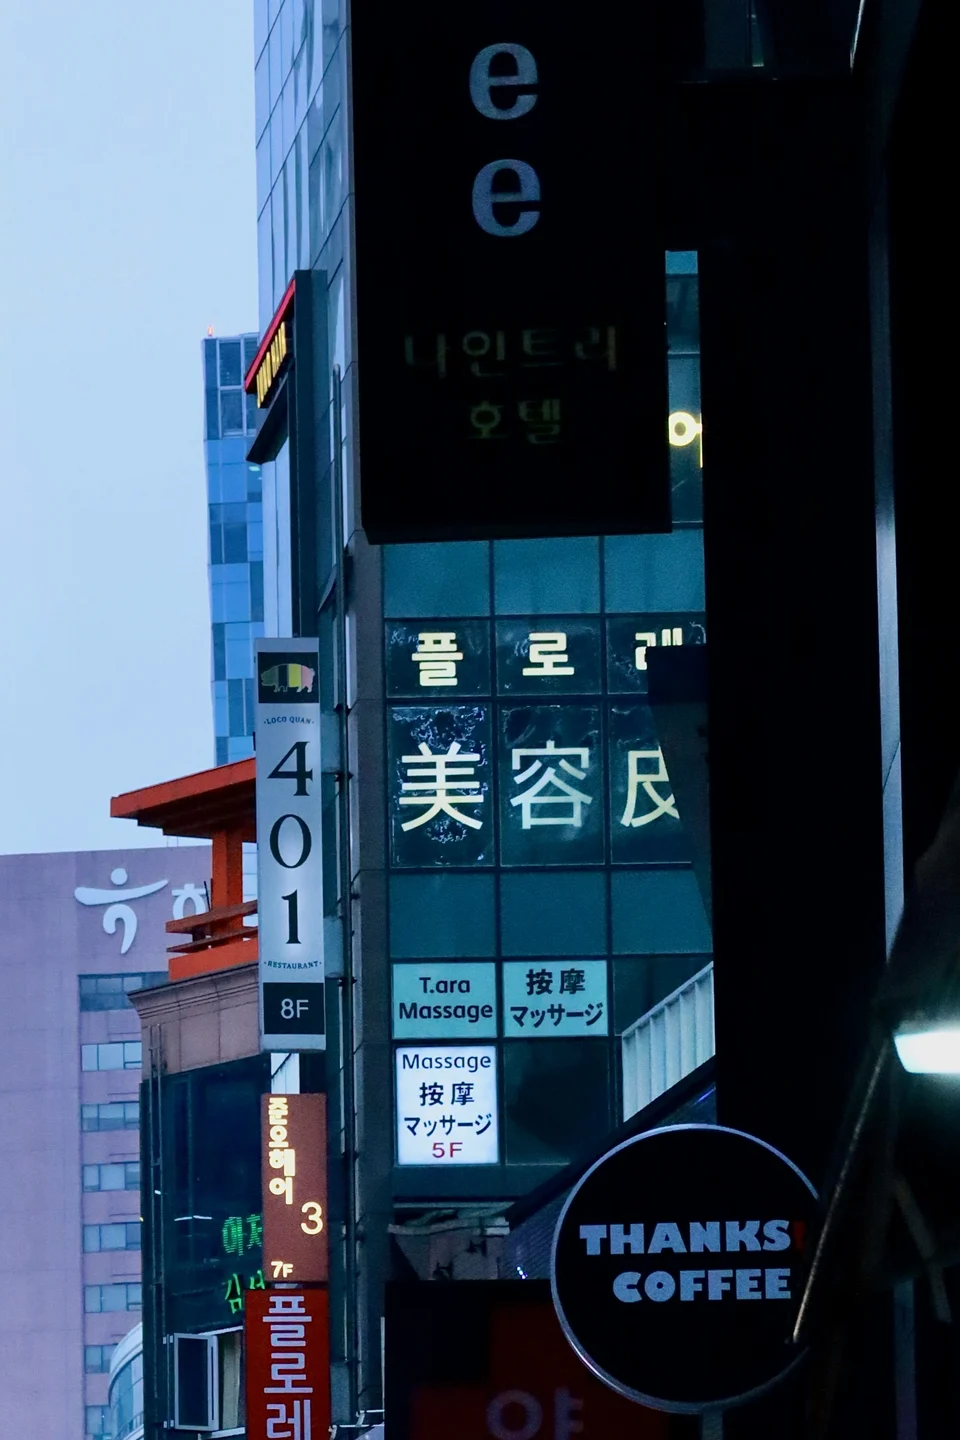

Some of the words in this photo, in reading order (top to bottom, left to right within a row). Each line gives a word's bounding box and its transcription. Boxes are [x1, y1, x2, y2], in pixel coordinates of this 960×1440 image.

[404, 325, 618, 380] 나인트리
[465, 398, 562, 445] 호텔
[268, 741, 314, 944] 401
[267, 960, 319, 970] RESTAURANT
[419, 976, 471, 995] T.ara
[525, 968, 586, 996] 按摩
[280, 999, 310, 1019] 8F
[398, 1002, 494, 1025] Massage
[510, 1003, 604, 1027] マッサージ
[401, 1053, 492, 1075] Massage
[419, 1081, 476, 1106] 按摩
[403, 1113, 493, 1138] マッサージ
[268, 1097, 296, 1206] 준오헤어
[431, 1142, 464, 1159] 5F
[300, 1201, 324, 1235] 3
[270, 1260, 294, 1278] 7F
[612, 1268, 792, 1303] COFFEE
